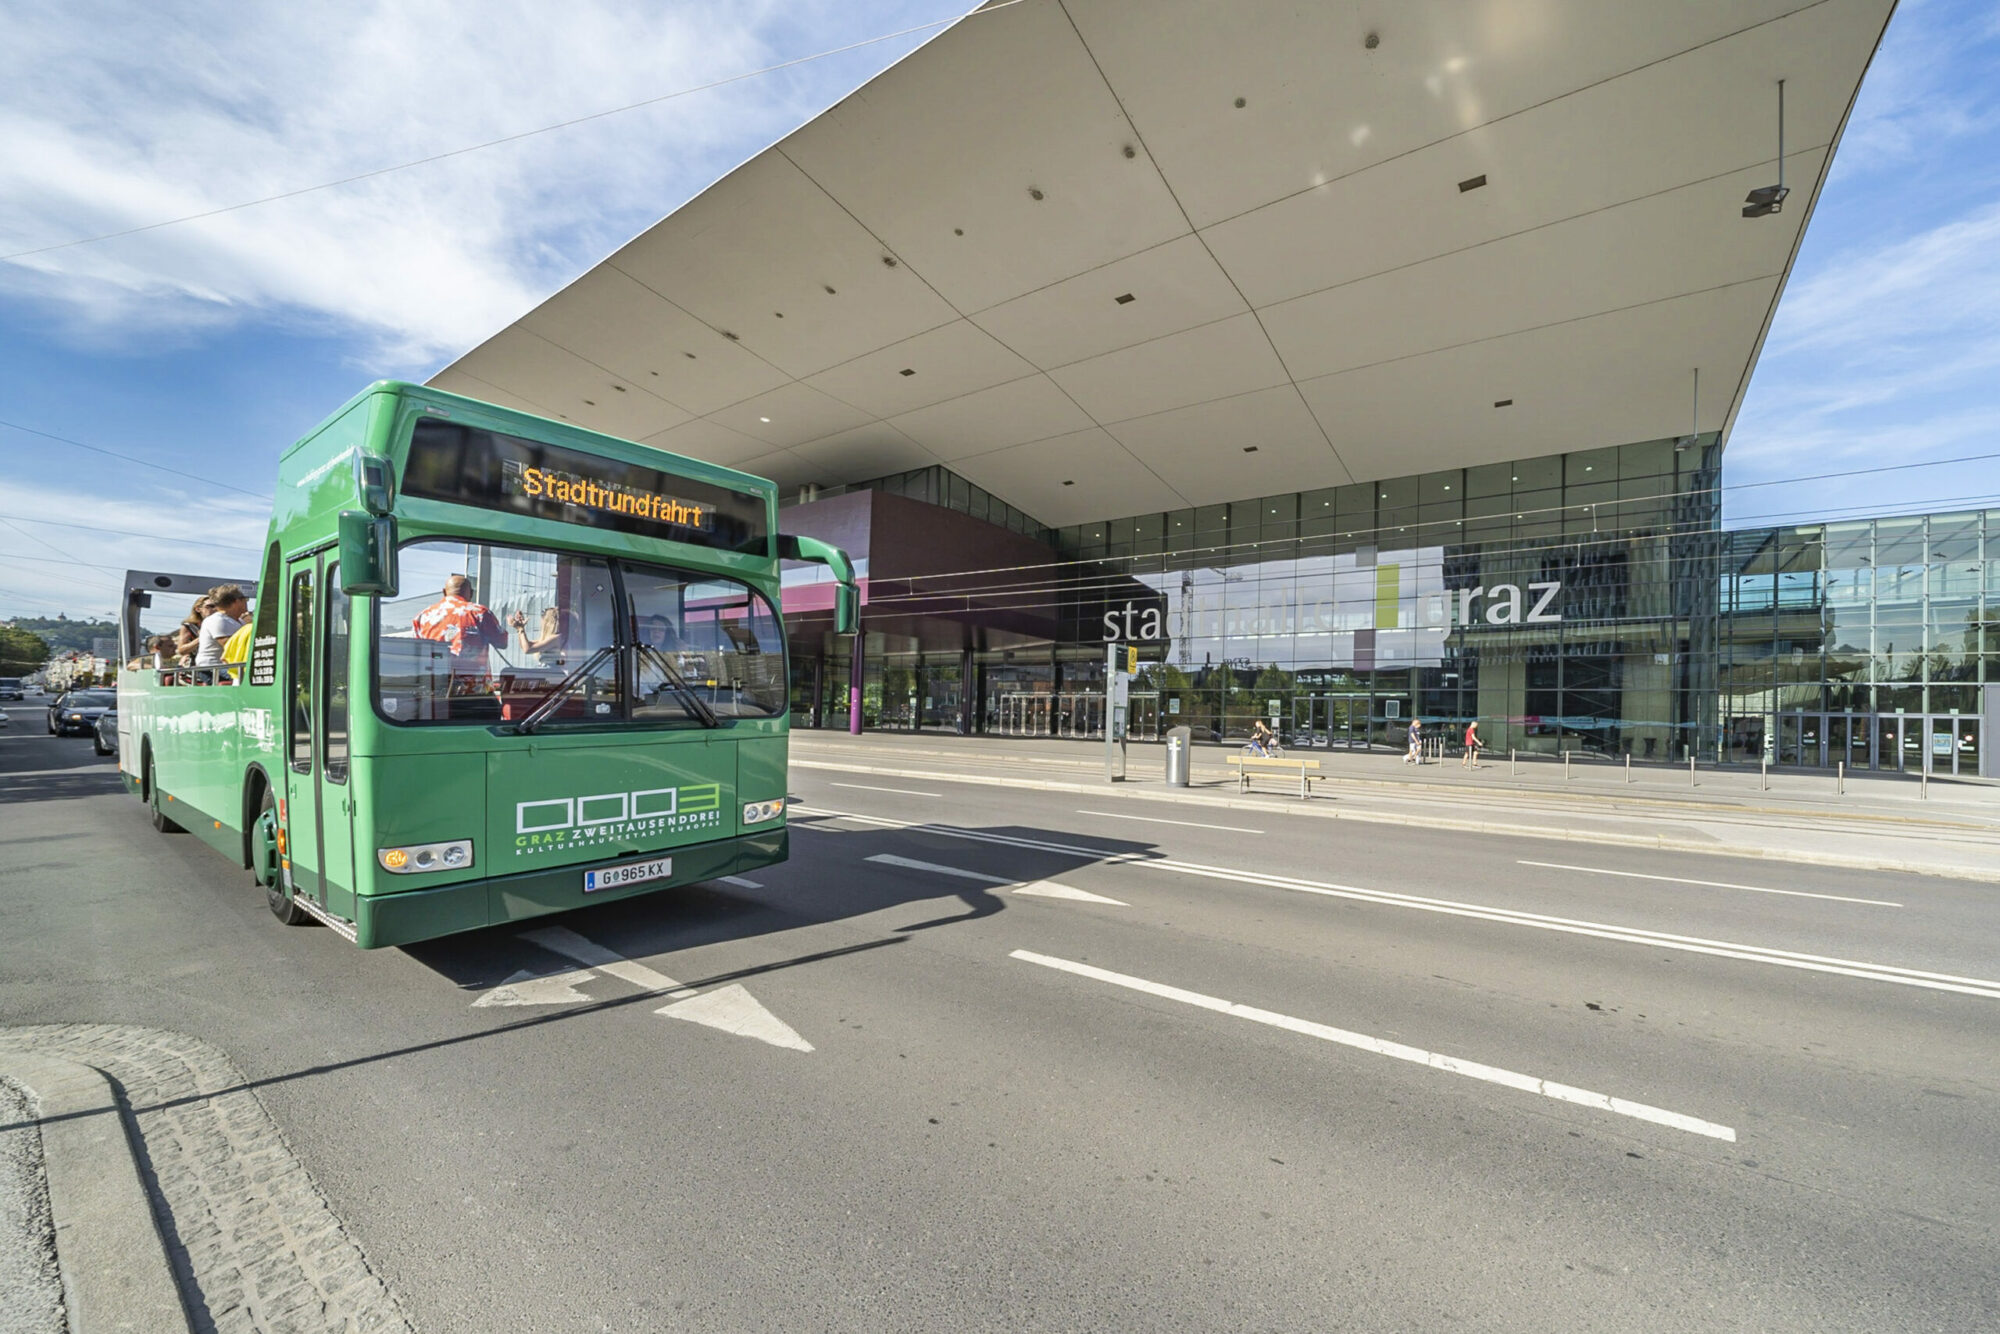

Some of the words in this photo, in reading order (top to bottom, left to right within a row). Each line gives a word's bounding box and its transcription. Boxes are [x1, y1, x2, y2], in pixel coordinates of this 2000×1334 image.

[523, 467, 702, 527] Stadtrundfahrt
[1417, 581, 1562, 643] graz
[515, 831, 565, 847] GRAZ
[572, 810, 720, 840] ZWEITAUSENDDREI
[516, 829, 663, 855] KULTURHAUPTSTADT
[670, 820, 720, 833] EUROPAS
